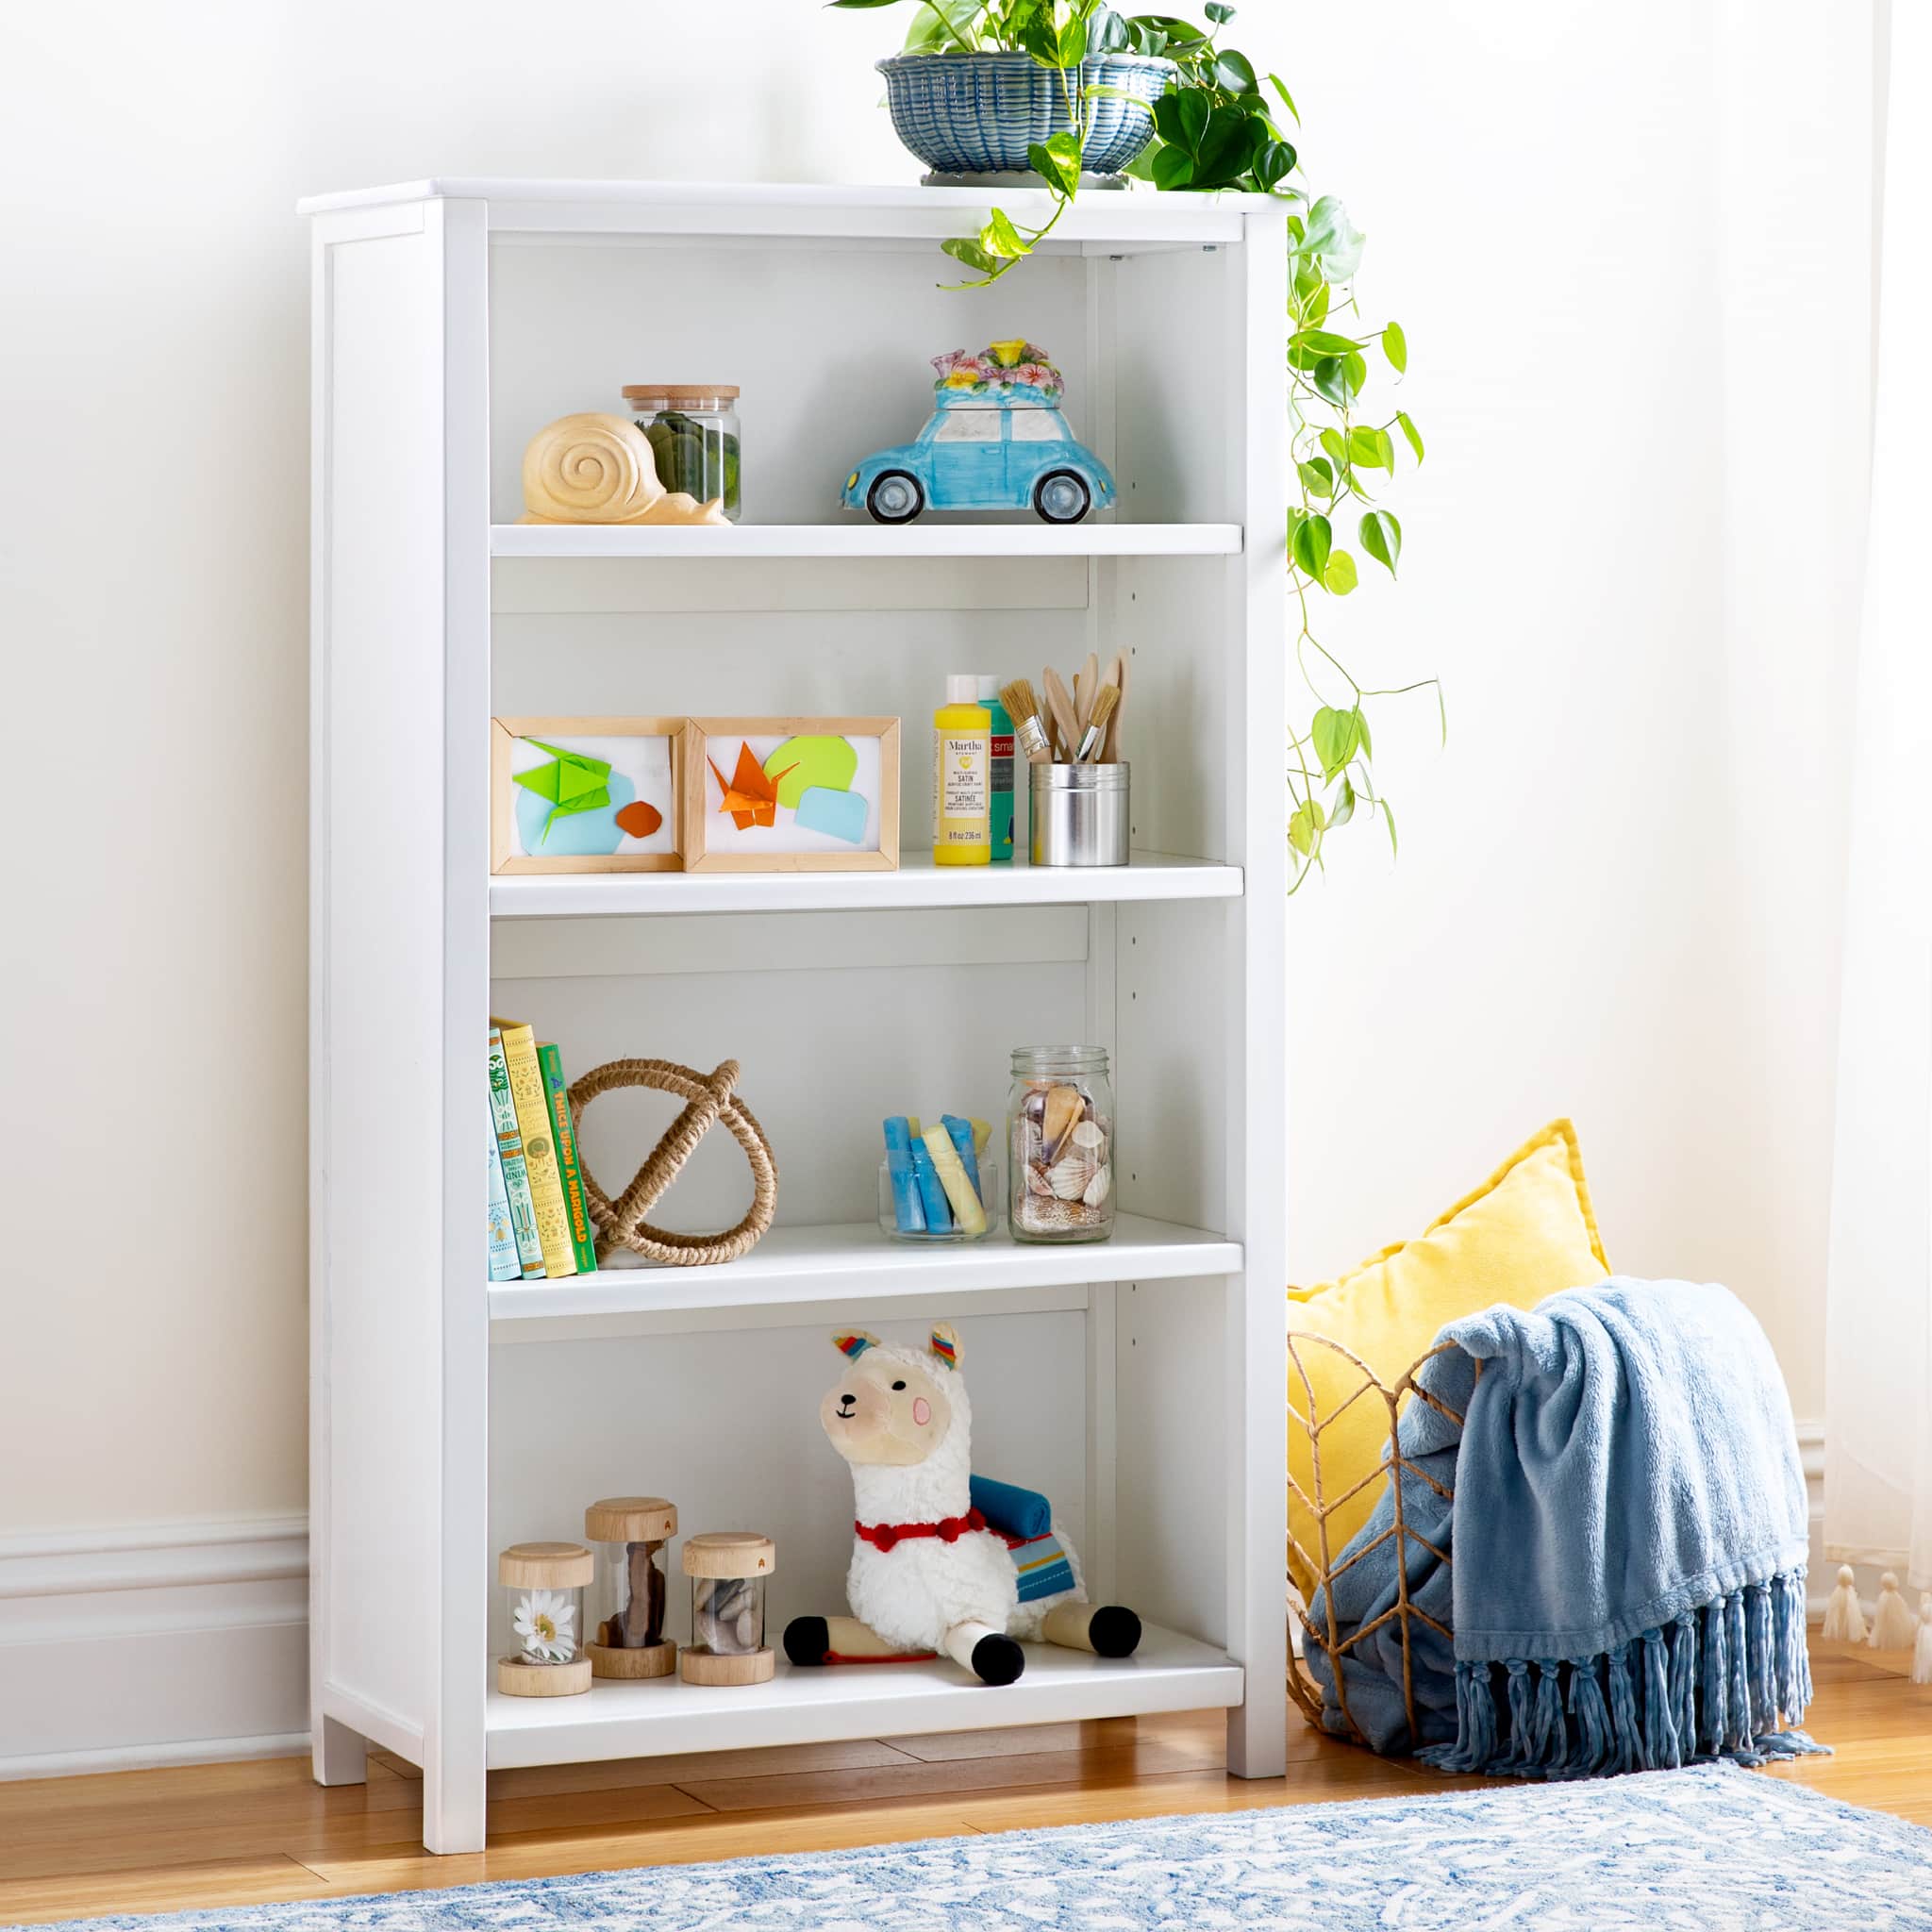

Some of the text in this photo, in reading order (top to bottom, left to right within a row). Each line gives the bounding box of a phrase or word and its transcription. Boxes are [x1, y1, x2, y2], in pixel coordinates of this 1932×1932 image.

[949, 741, 982, 751] Martha
[965, 831, 974, 840] 236
[553, 1091, 568, 1128] TWICE
[559, 1131, 575, 1166] UPON
[506, 1169, 527, 1180] WIND
[566, 1169, 577, 1178] A
[568, 1180, 589, 1243] MARIGOLD
